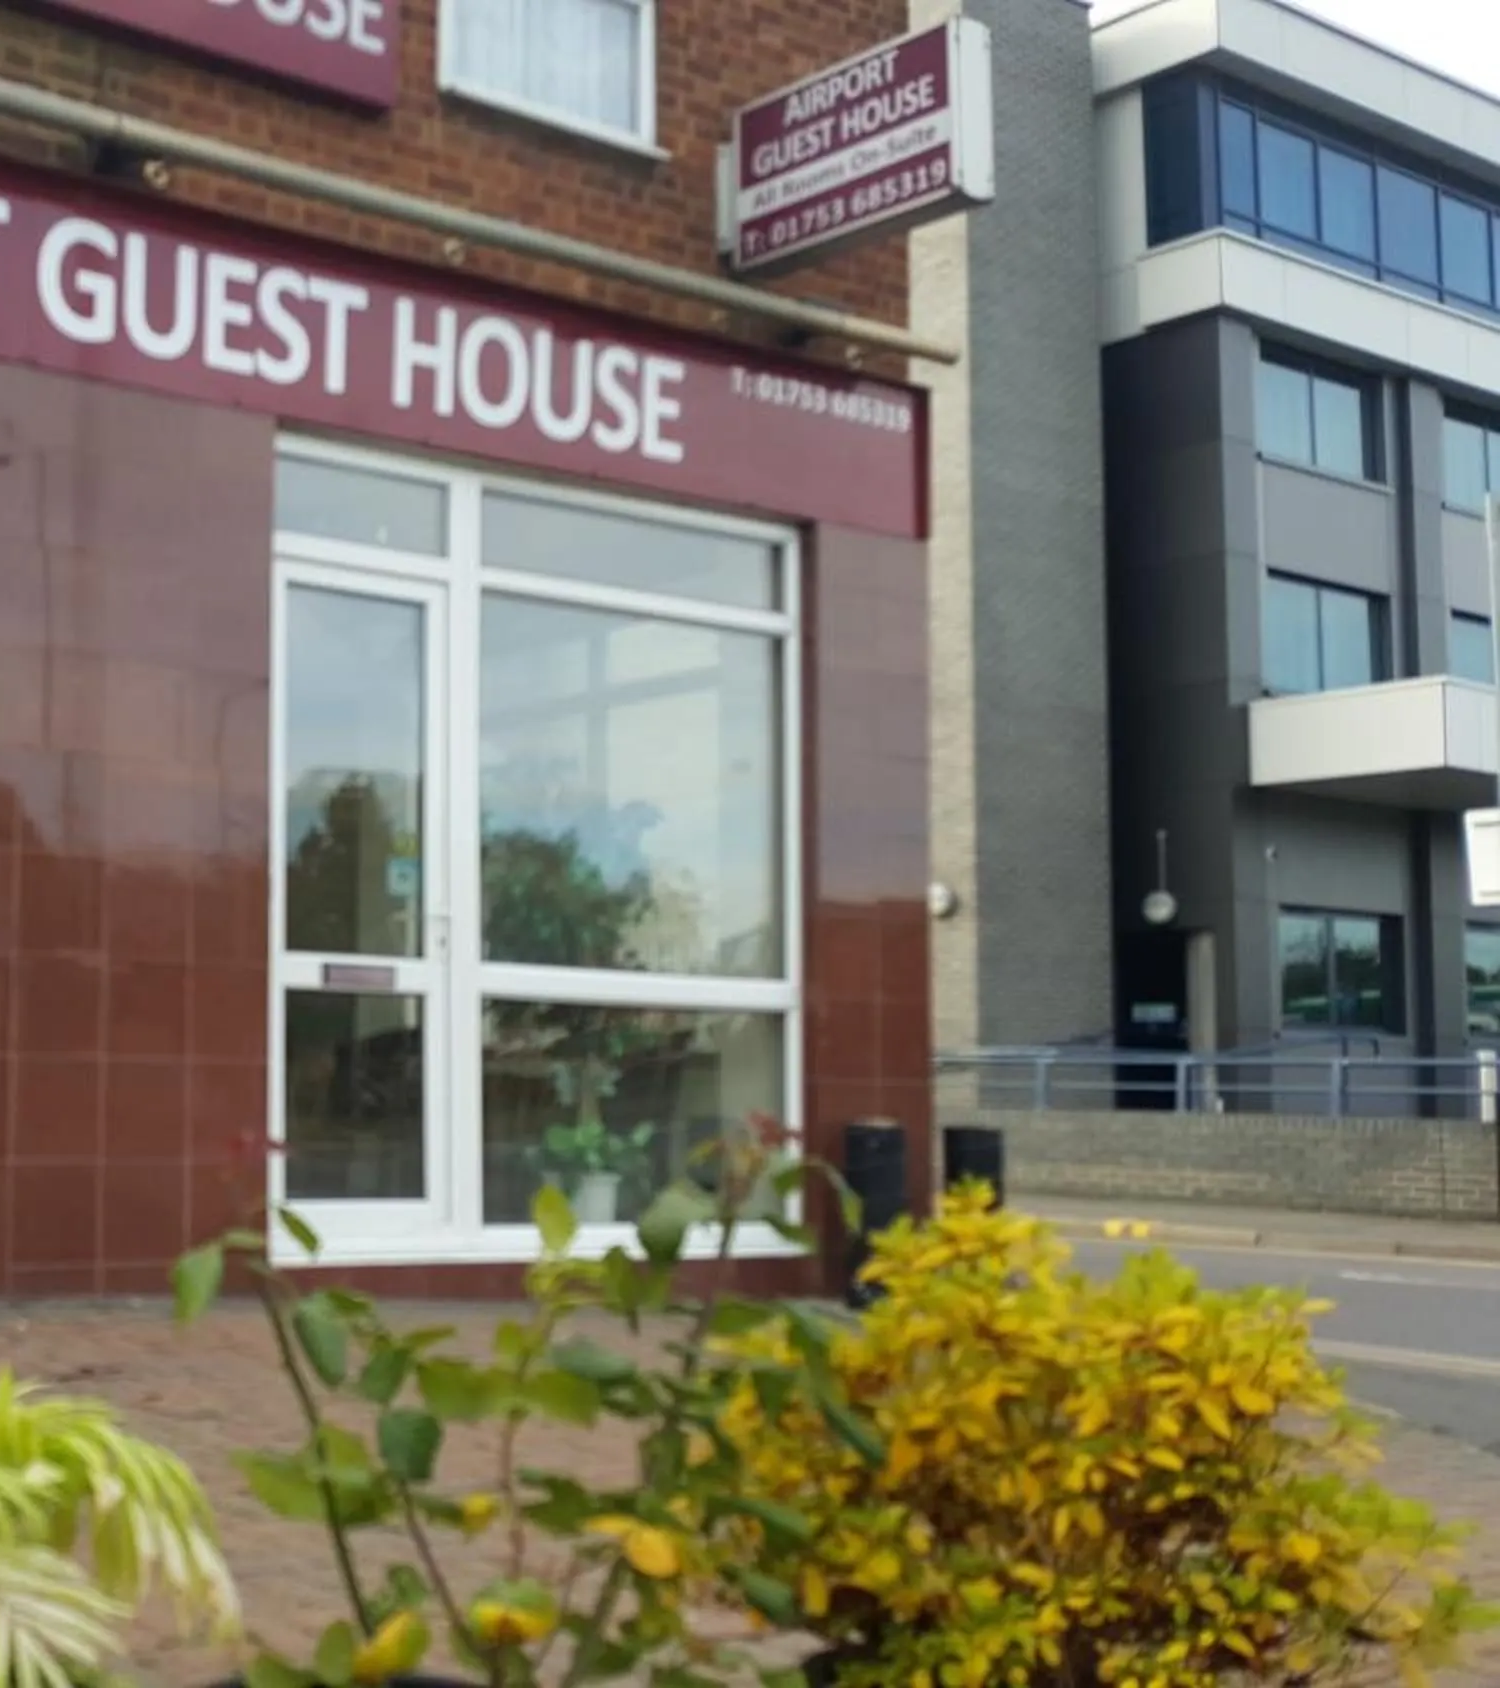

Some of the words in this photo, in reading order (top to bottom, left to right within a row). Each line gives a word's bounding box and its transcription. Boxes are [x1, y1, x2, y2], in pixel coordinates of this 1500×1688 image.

[752, 117, 835, 178] GUEST
[841, 73, 934, 141] HOUSE
[783, 50, 899, 126] AIRPORT
[754, 185, 777, 210] All
[783, 164, 845, 196] Rooms
[770, 197, 845, 246] 01753
[852, 158, 947, 216] 685319
[36, 216, 369, 396] GUEST
[391, 297, 685, 463] HOUSE
